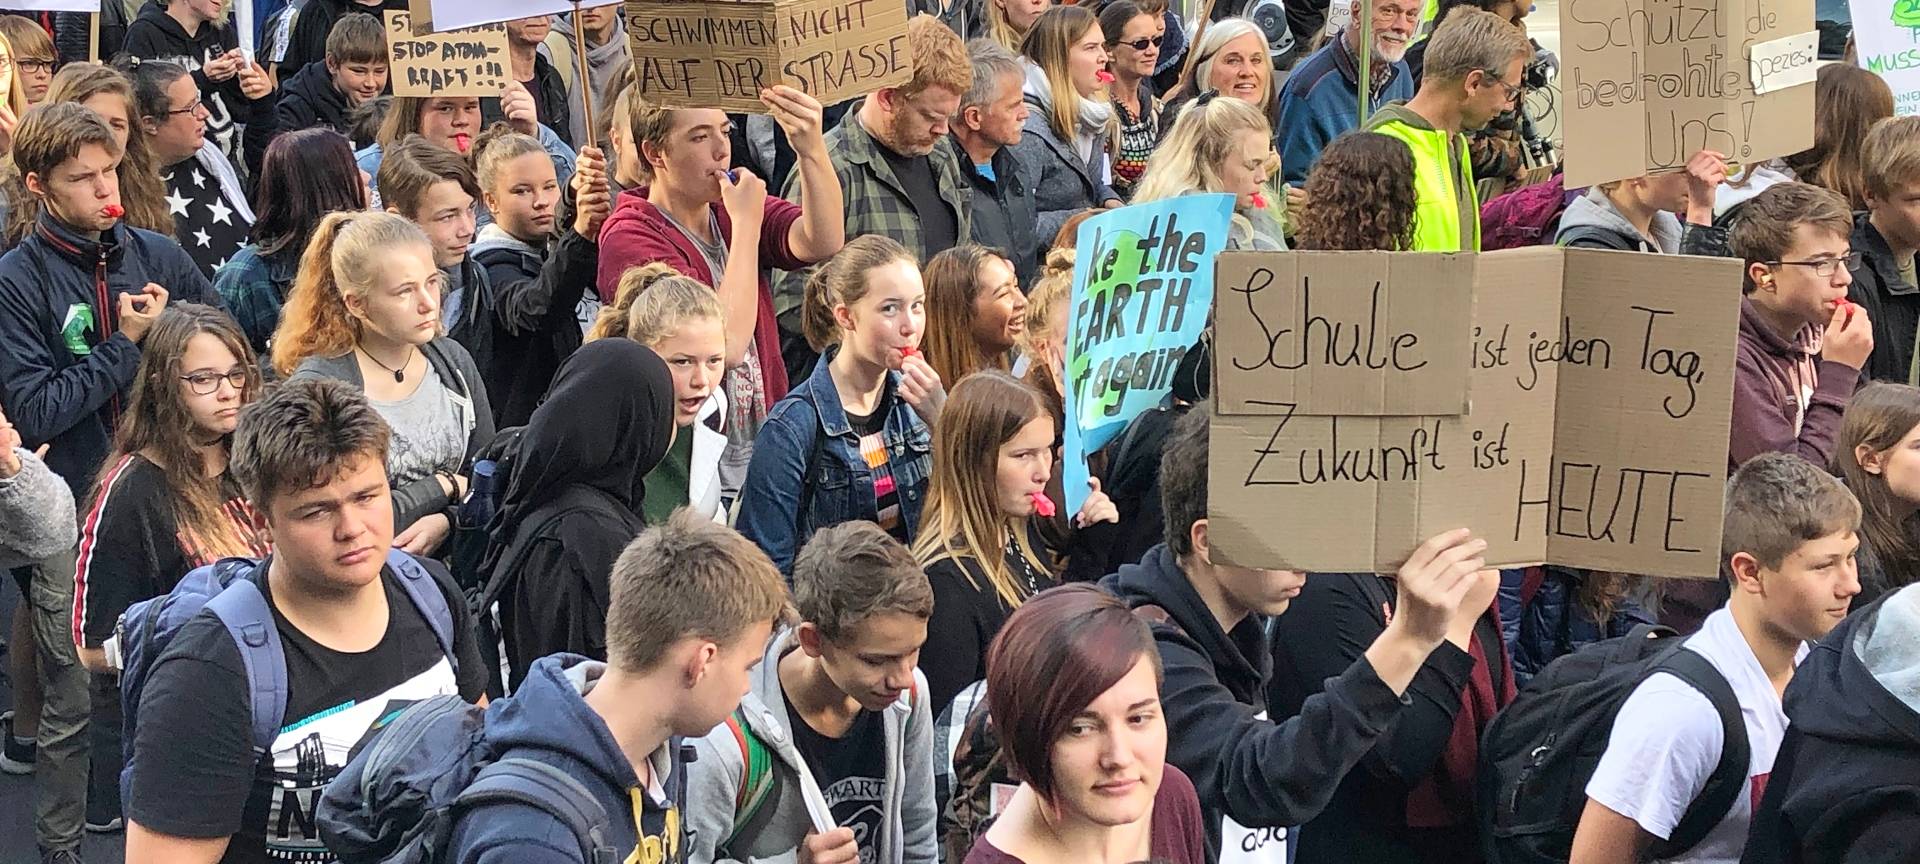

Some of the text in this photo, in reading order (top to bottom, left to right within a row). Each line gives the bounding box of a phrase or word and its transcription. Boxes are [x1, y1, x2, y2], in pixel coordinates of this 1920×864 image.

[393, 41, 501, 61] STOP ATOM-
[1570, 0, 1777, 51] Schützt die
[407, 66, 468, 94] KRAFT
[642, 35, 907, 97] AUF DER STRASSE
[1574, 38, 1814, 109] bedrohte Spezies:
[1081, 213, 1205, 291] ke the
[1074, 278, 1192, 360] EARTH
[1231, 268, 1705, 418] Schule ist jeden Tag,
[737, 384, 753, 392] NO
[1092, 345, 1187, 417] again
[1245, 400, 1510, 487] Zukunft ist
[1515, 456, 1710, 553] HEUTE
[825, 779, 886, 802] WART
